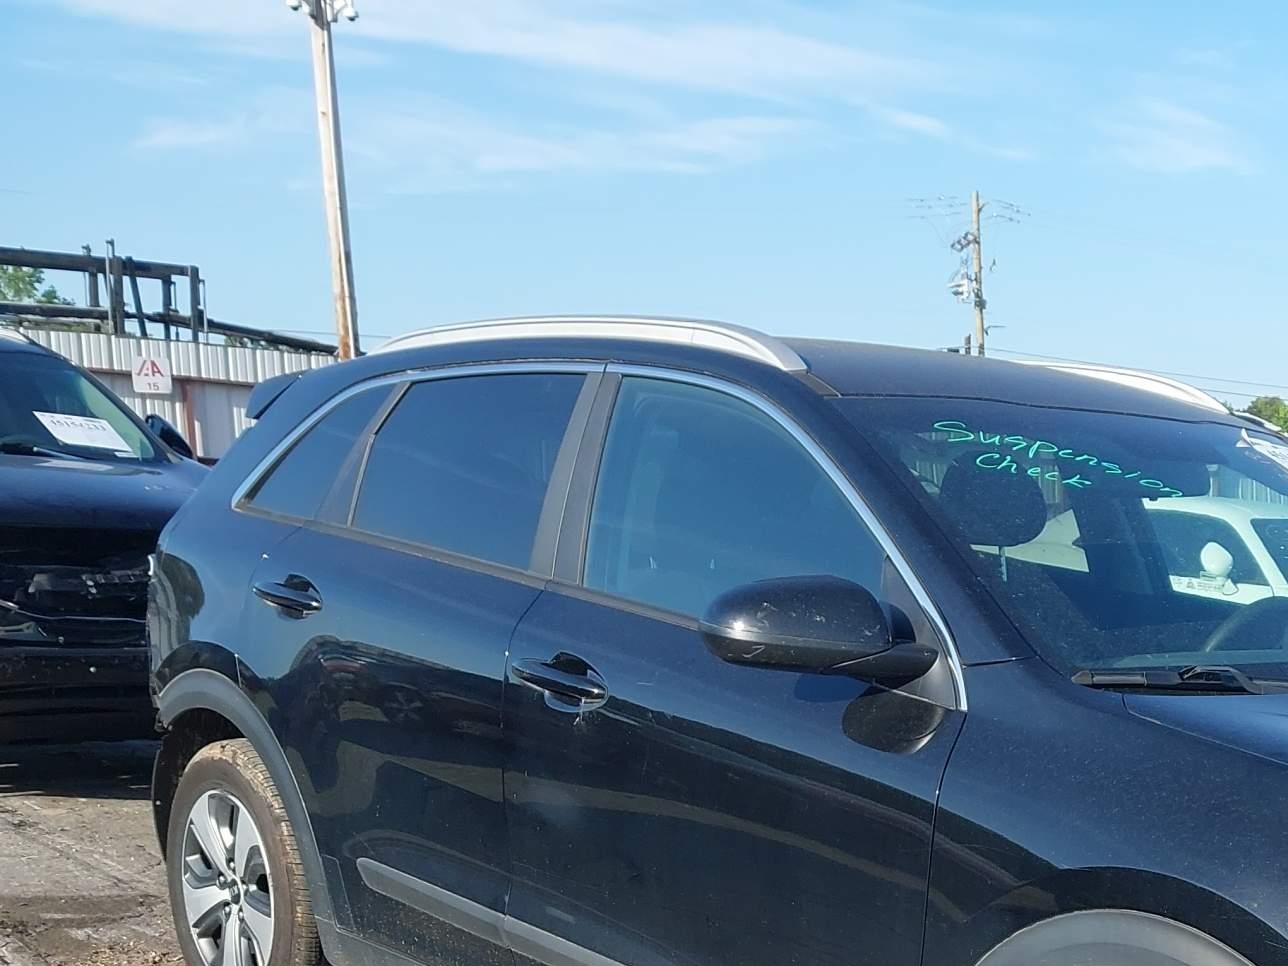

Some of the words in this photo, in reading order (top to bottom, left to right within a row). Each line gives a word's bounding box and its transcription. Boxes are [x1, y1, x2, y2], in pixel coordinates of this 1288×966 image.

[146, 382, 160, 391] 15
[933, 420, 1183, 498] Suspension
[975, 452, 1093, 489] Check
